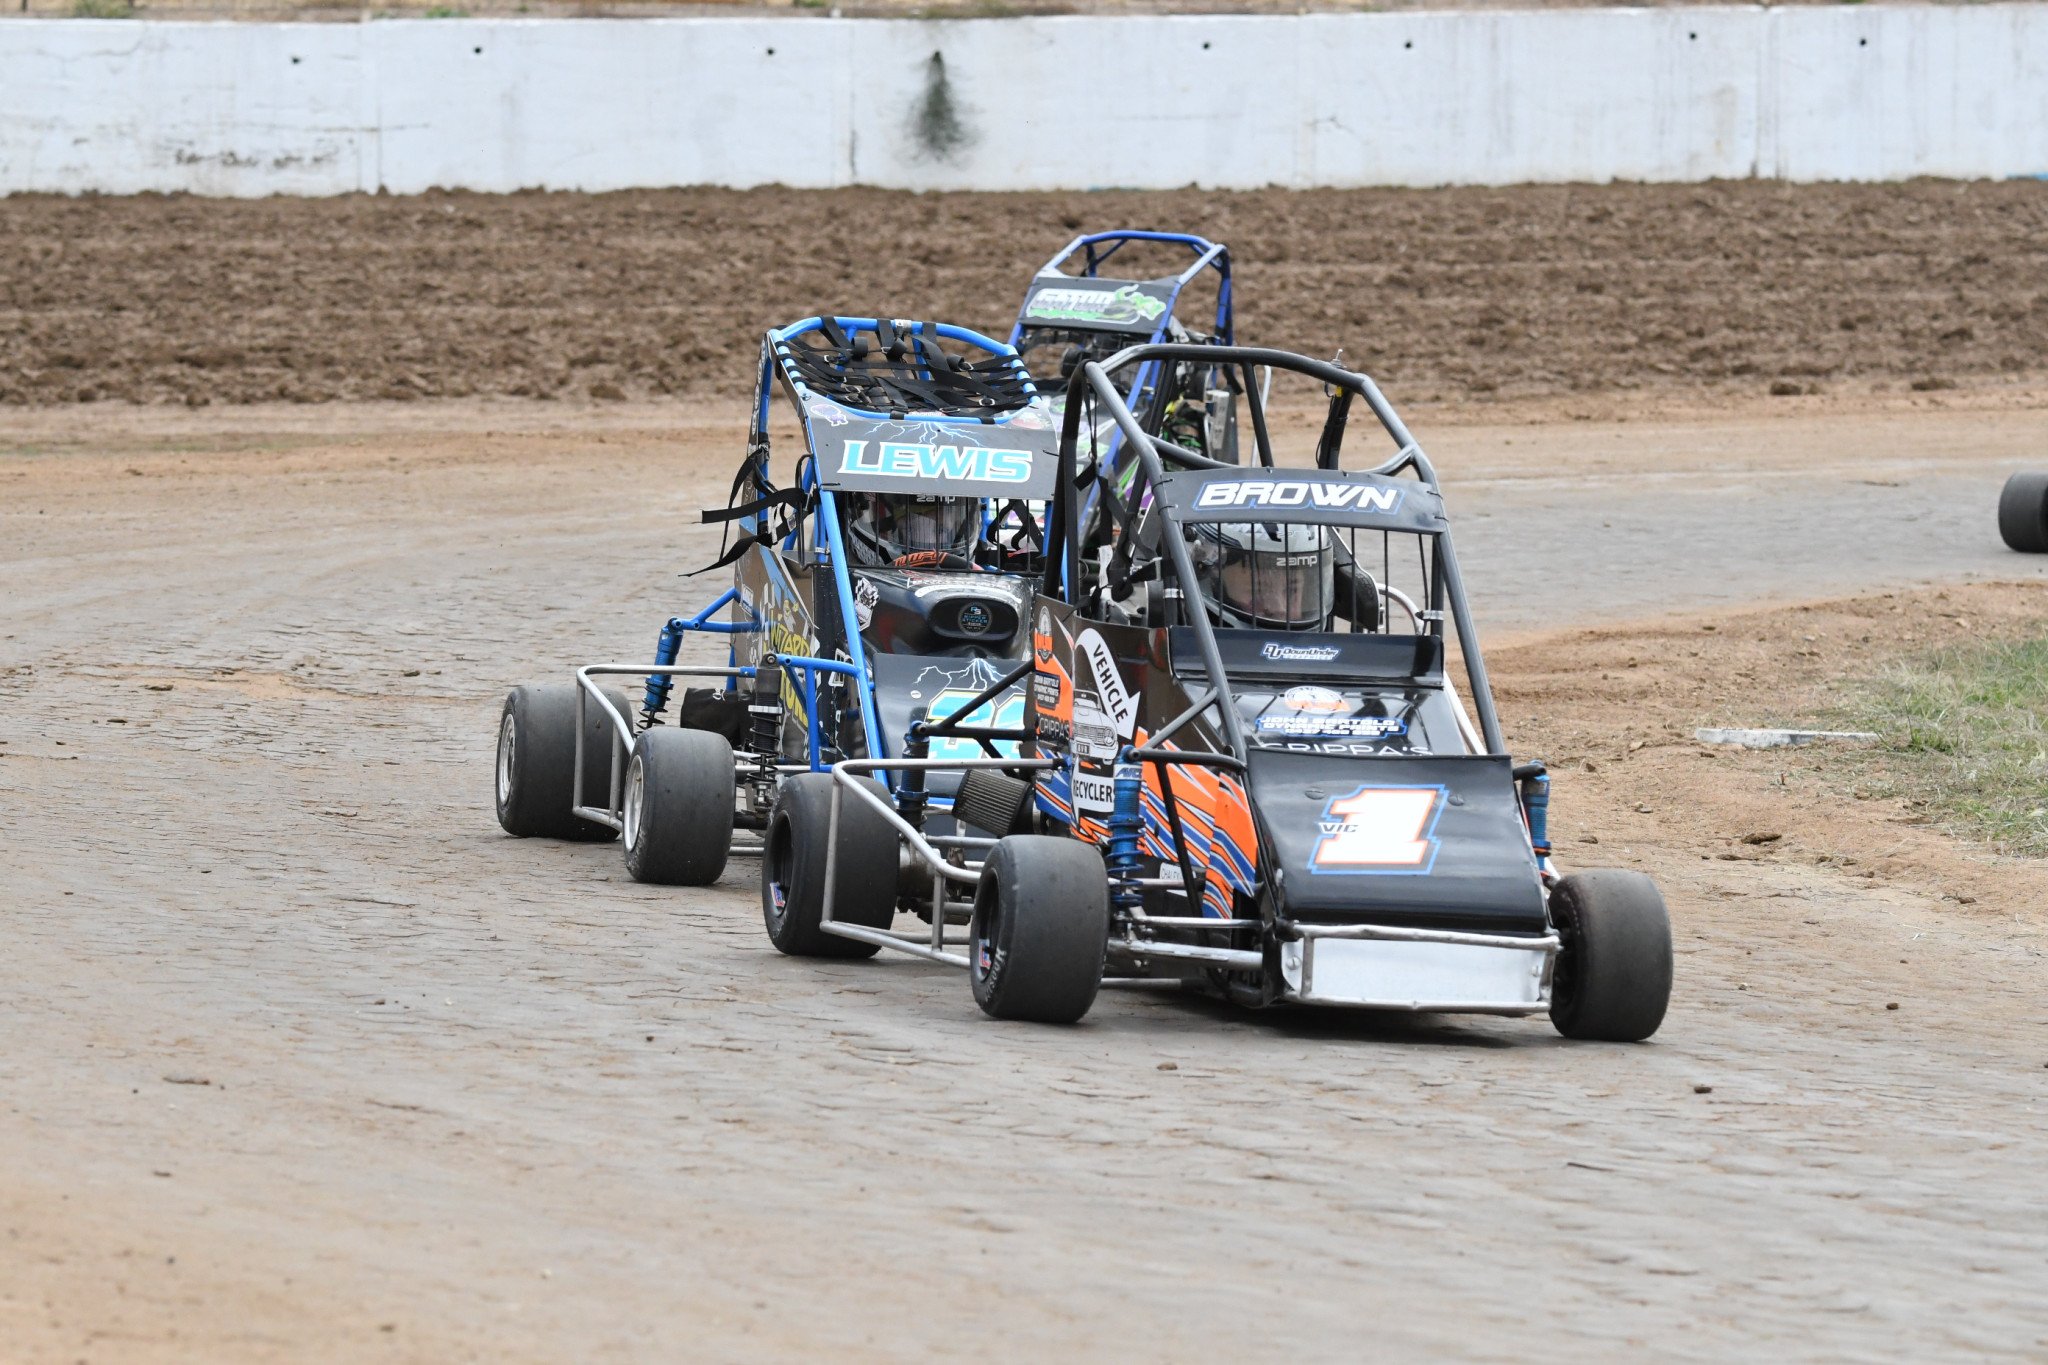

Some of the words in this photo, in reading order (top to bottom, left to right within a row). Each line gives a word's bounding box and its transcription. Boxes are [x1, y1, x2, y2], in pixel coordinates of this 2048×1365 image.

[837, 440, 1033, 483] LEWIS
[1198, 482, 1397, 510] BROWN
[1275, 555, 1318, 567] zamp
[1093, 643, 1129, 724] VEHICLE
[1073, 779, 1114, 804] RECYCLER
[1315, 788, 1437, 864] 1
[1322, 824, 1359, 833] VIC
